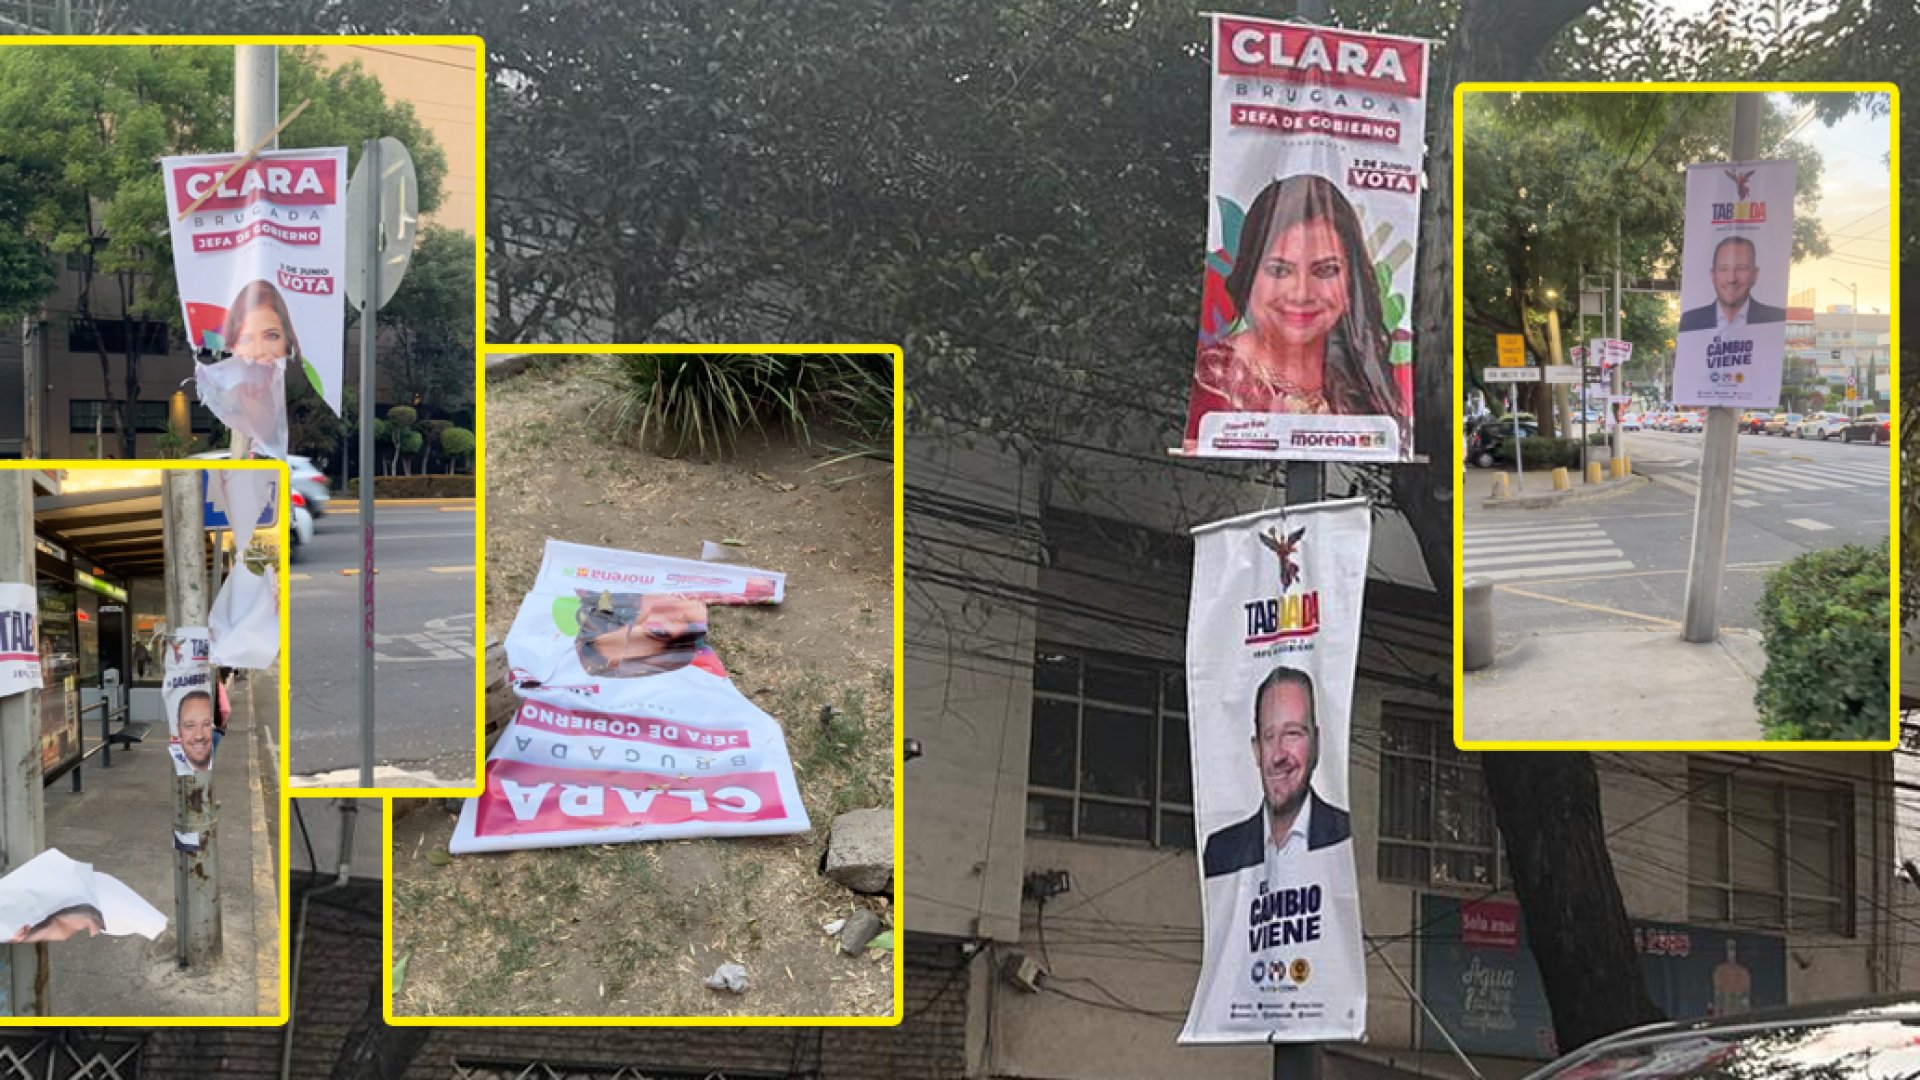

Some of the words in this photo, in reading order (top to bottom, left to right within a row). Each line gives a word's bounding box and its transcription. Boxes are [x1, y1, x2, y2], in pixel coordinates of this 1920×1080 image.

[1232, 28, 1407, 83] CLARA
[1235, 83, 1400, 114] BRUGADA
[1237, 110, 1278, 127] JEFA
[1282, 116, 1304, 130] DE
[1308, 116, 1398, 139] GOBIERNO
[186, 167, 324, 200] CLARA
[1353, 170, 1413, 192] VOTA
[194, 206, 320, 227] BRUGADA
[1711, 202, 1767, 220] TABDA
[198, 236, 232, 248] JEFA
[236, 231, 250, 244] DE
[253, 222, 319, 241] GOBIERNO
[279, 271, 330, 293] VOTA
[1707, 339, 1753, 357] CAMBIO
[1706, 353, 1752, 369] VIENE
[1290, 431, 1356, 448] morena
[590, 569, 655, 585] morena
[521, 704, 641, 737] GOBIERNO
[649, 724, 679, 740] DE
[686, 728, 739, 746] JEFA
[514, 735, 748, 770] BRUGADA
[501, 778, 762, 821] CLARA
[1250, 885, 1321, 927] CAMBIO
[1249, 914, 1321, 953] VIENE
